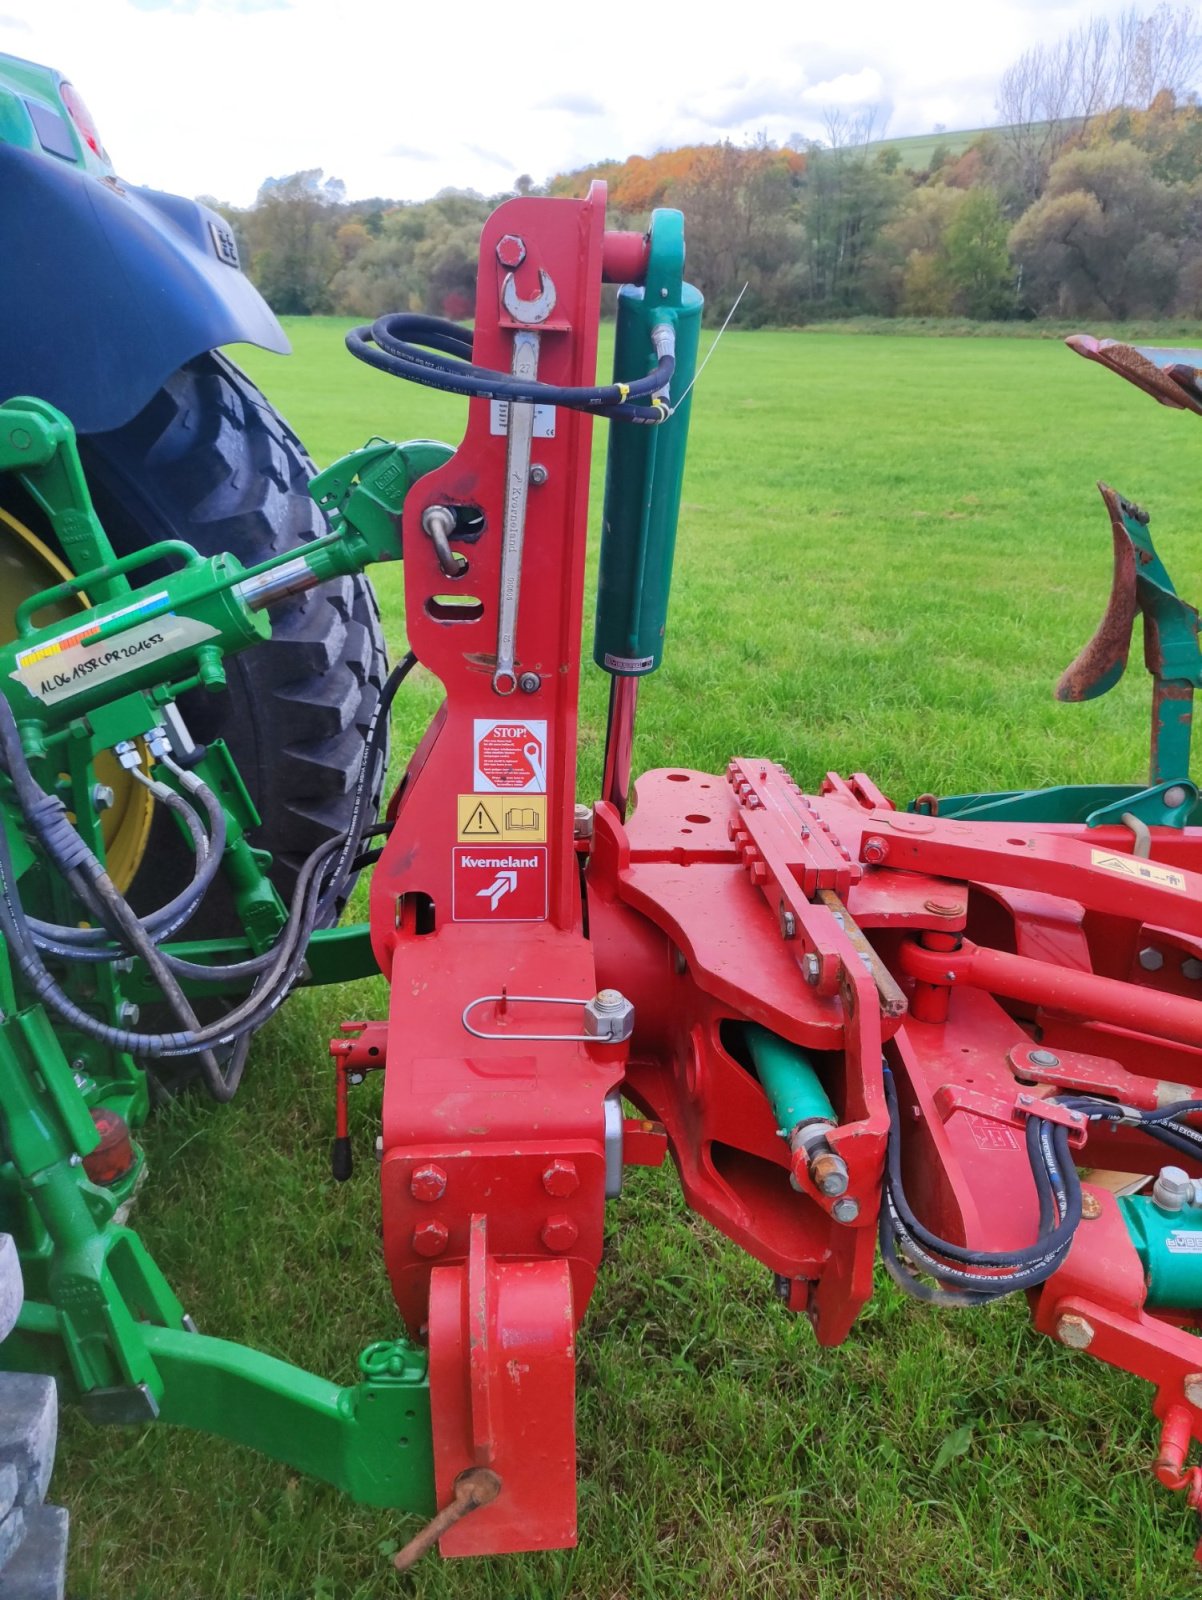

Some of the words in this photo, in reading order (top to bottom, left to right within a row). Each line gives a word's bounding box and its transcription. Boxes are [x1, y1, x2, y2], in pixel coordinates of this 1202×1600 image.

[520, 364, 530, 374] 27
[493, 727, 527, 738] STOP!
[461, 856, 538, 868] Kverneland
